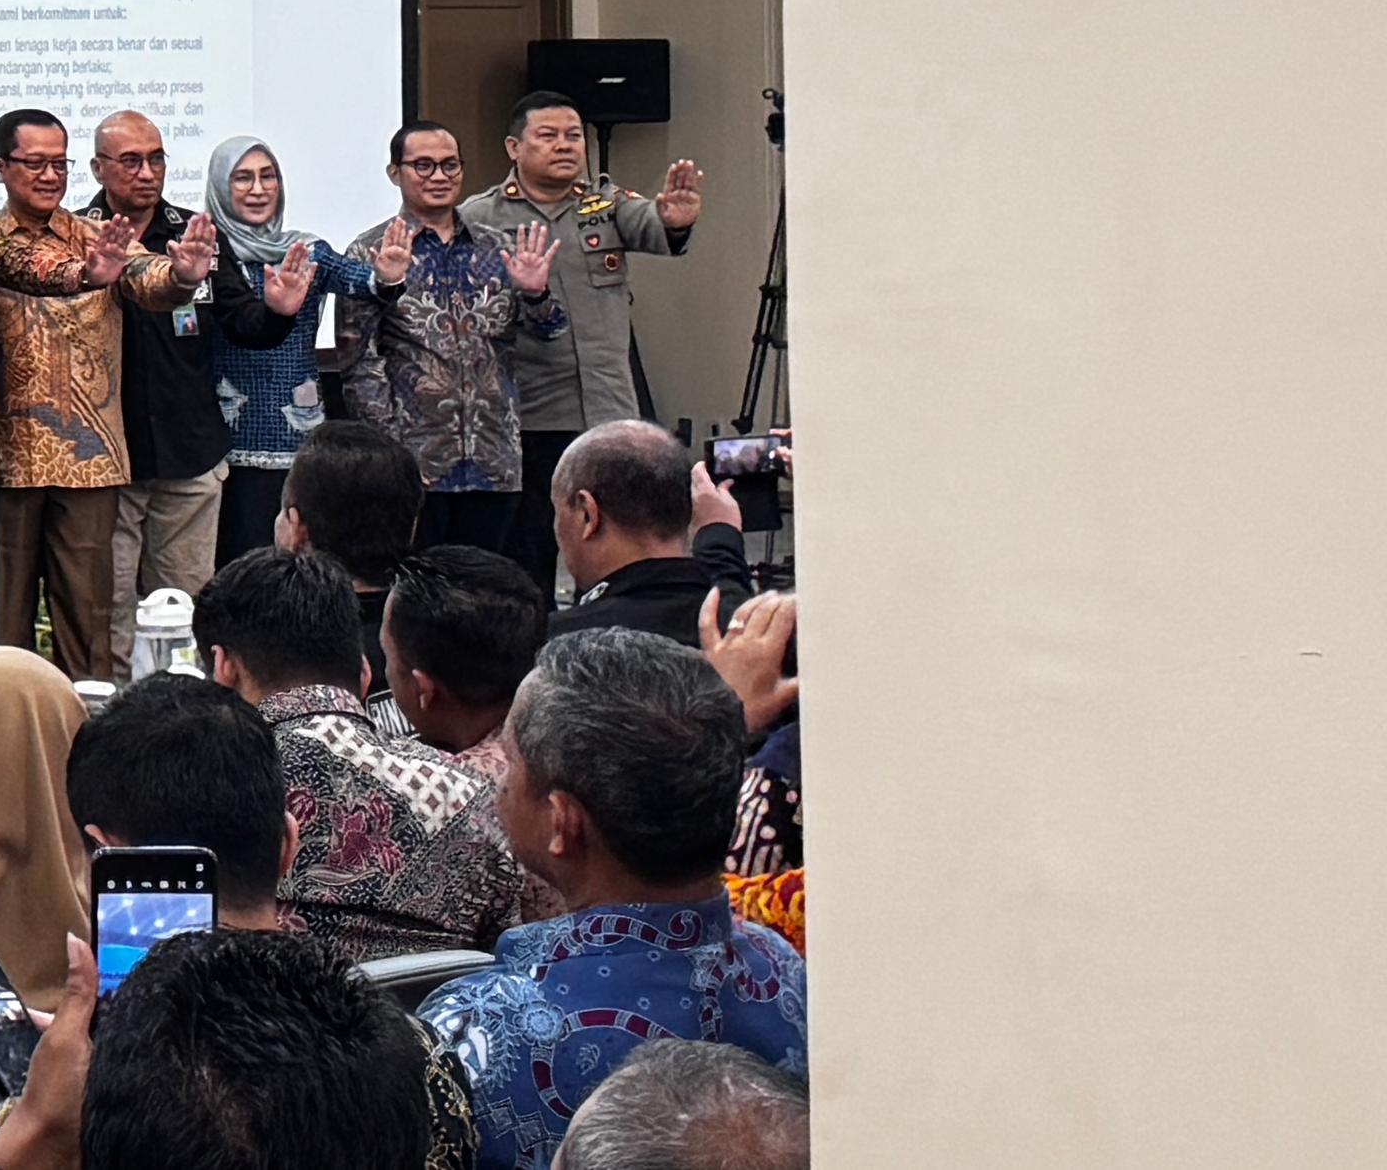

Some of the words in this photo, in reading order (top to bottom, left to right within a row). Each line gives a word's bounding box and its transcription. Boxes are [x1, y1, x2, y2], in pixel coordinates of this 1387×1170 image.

[15, 38, 50, 55] tenaga
[53, 37, 78, 55] kerja
[81, 38, 114, 52] secara
[117, 36, 147, 51] benar
[149, 36, 168, 50] dan
[171, 36, 203, 50] sesuai
[45, 61, 70, 77] yang
[138, 81, 168, 96] setiap
[170, 81, 203, 96] proses
[184, 102, 204, 116] dan
